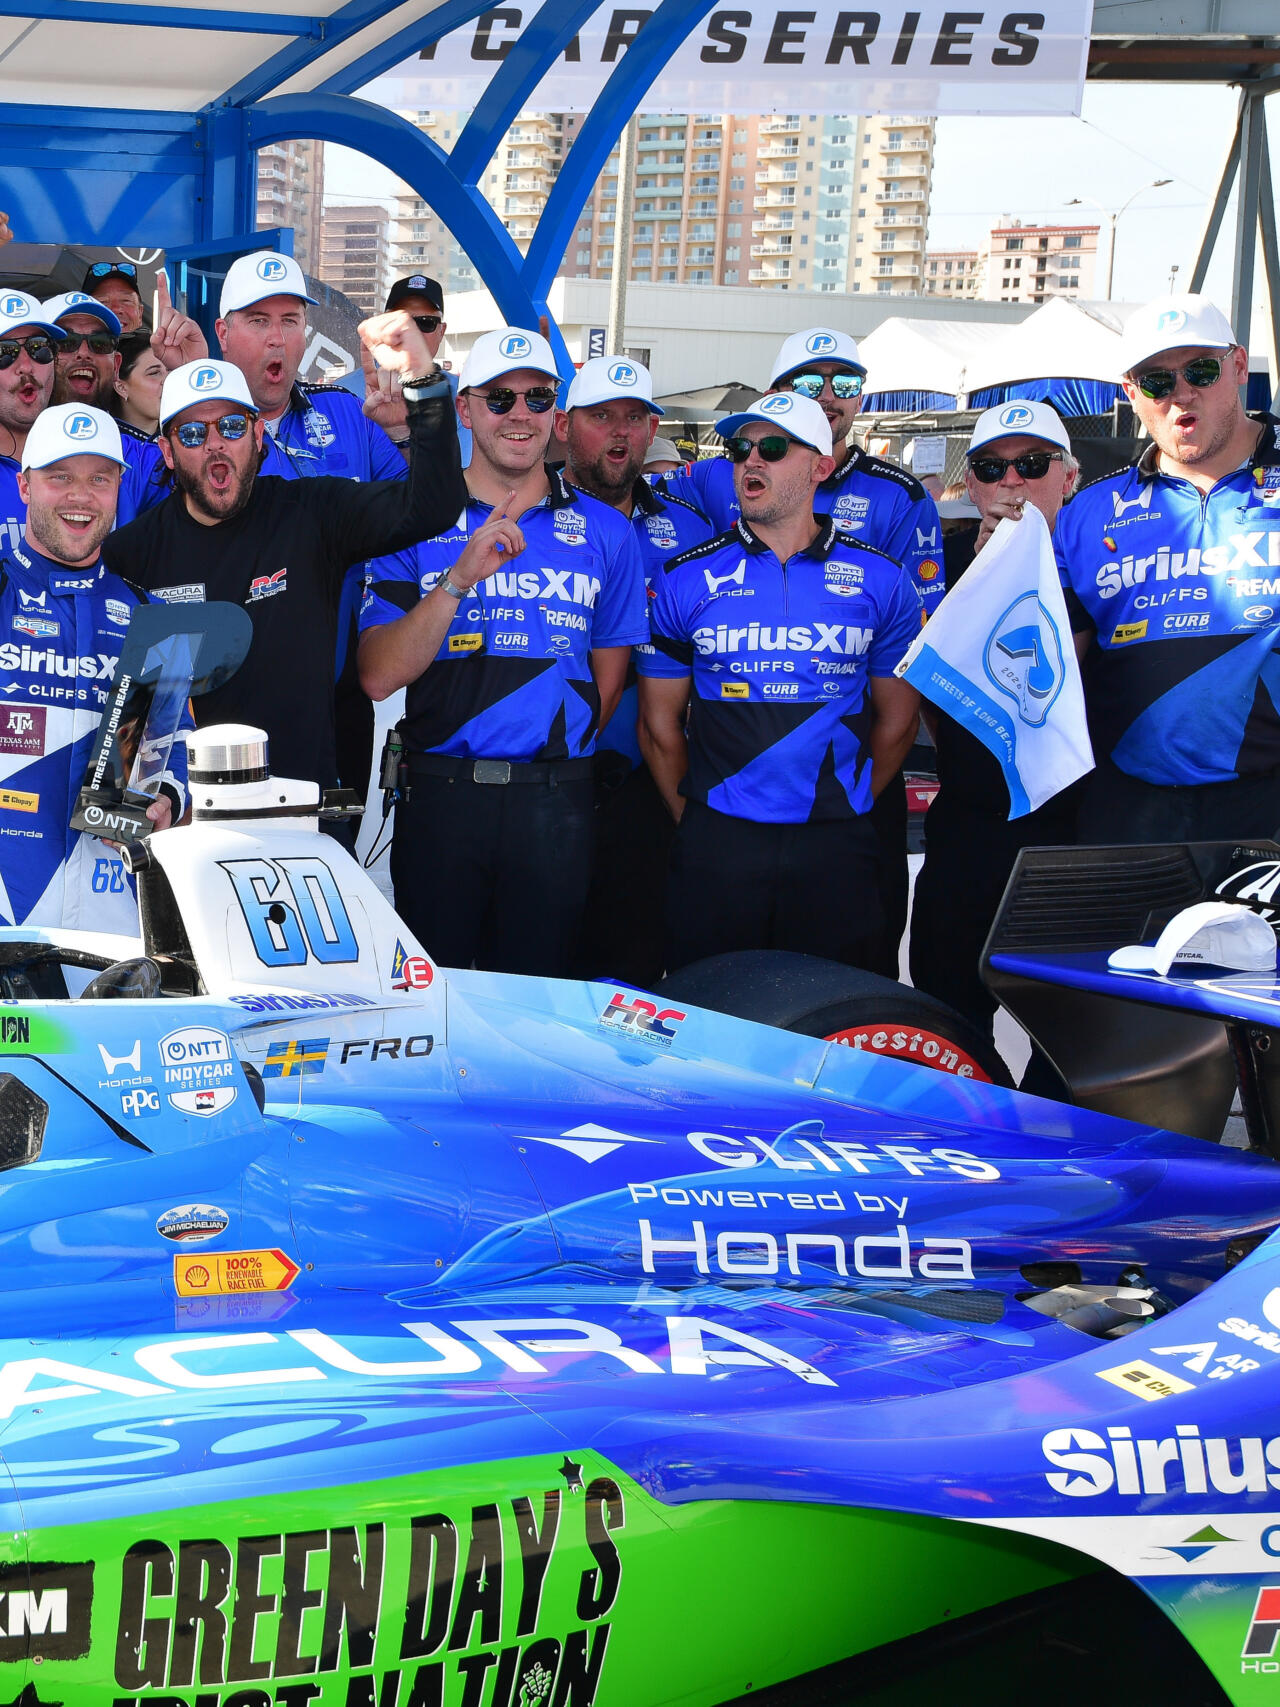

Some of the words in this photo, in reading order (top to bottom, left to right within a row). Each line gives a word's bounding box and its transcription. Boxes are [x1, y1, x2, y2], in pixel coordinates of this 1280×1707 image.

[700, 11, 1045, 66] SERIES
[871, 464, 914, 486] Firestone
[833, 508, 867, 519] INDYCAR
[1104, 511, 1161, 531] Honda
[55, 578, 95, 589] HRX
[824, 573, 864, 584] INDYCAR
[1235, 579, 1280, 598] REM
[161, 585, 202, 599] ACURA
[467, 608, 525, 622] CLIFFS
[1163, 614, 1210, 628] CURB
[494, 633, 529, 646] CURB
[691, 622, 874, 656] SiriusXM
[729, 661, 795, 673] CLIFFS
[114, 674, 132, 707] BEACH
[763, 684, 799, 695] CURB
[930, 671, 965, 702] STREETS
[961, 694, 975, 709] OF
[973, 706, 996, 728] LONG
[108, 708, 122, 734] LONG
[104, 736, 114, 748] OF
[91, 749, 110, 791] STREETS
[0, 828, 43, 839] Honda
[104, 812, 143, 835] NTT
[91, 858, 125, 894] 60
[214, 856, 360, 968] 60
[408, 961, 429, 986] E
[228, 993, 377, 1013] SiriusXM
[602, 991, 688, 1038] HRC
[635, 1028, 673, 1046] RACING
[187, 1040, 223, 1058] NTT
[340, 1034, 434, 1065] FRO
[829, 1030, 975, 1079] restone
[98, 1074, 153, 1089] Honda
[165, 1062, 233, 1083] INDYCAR
[180, 1078, 221, 1089] SERIES
[686, 1132, 1002, 1180] CLIFFS
[627, 1183, 846, 1212] Powered
[860, 1191, 909, 1219] by
[162, 1224, 177, 1234] JIM
[177, 1220, 224, 1233] MICHAELIAN
[639, 1218, 976, 1281] Honda
[226, 1257, 262, 1270] 100%
[225, 1269, 263, 1280] RENEWABLE
[227, 1280, 247, 1291] RACE
[247, 1278, 267, 1289] FUEL
[1041, 1423, 1280, 1498] Siriu
[113, 1520, 387, 1692] GREEN
[399, 1455, 626, 1662] DAY'S
